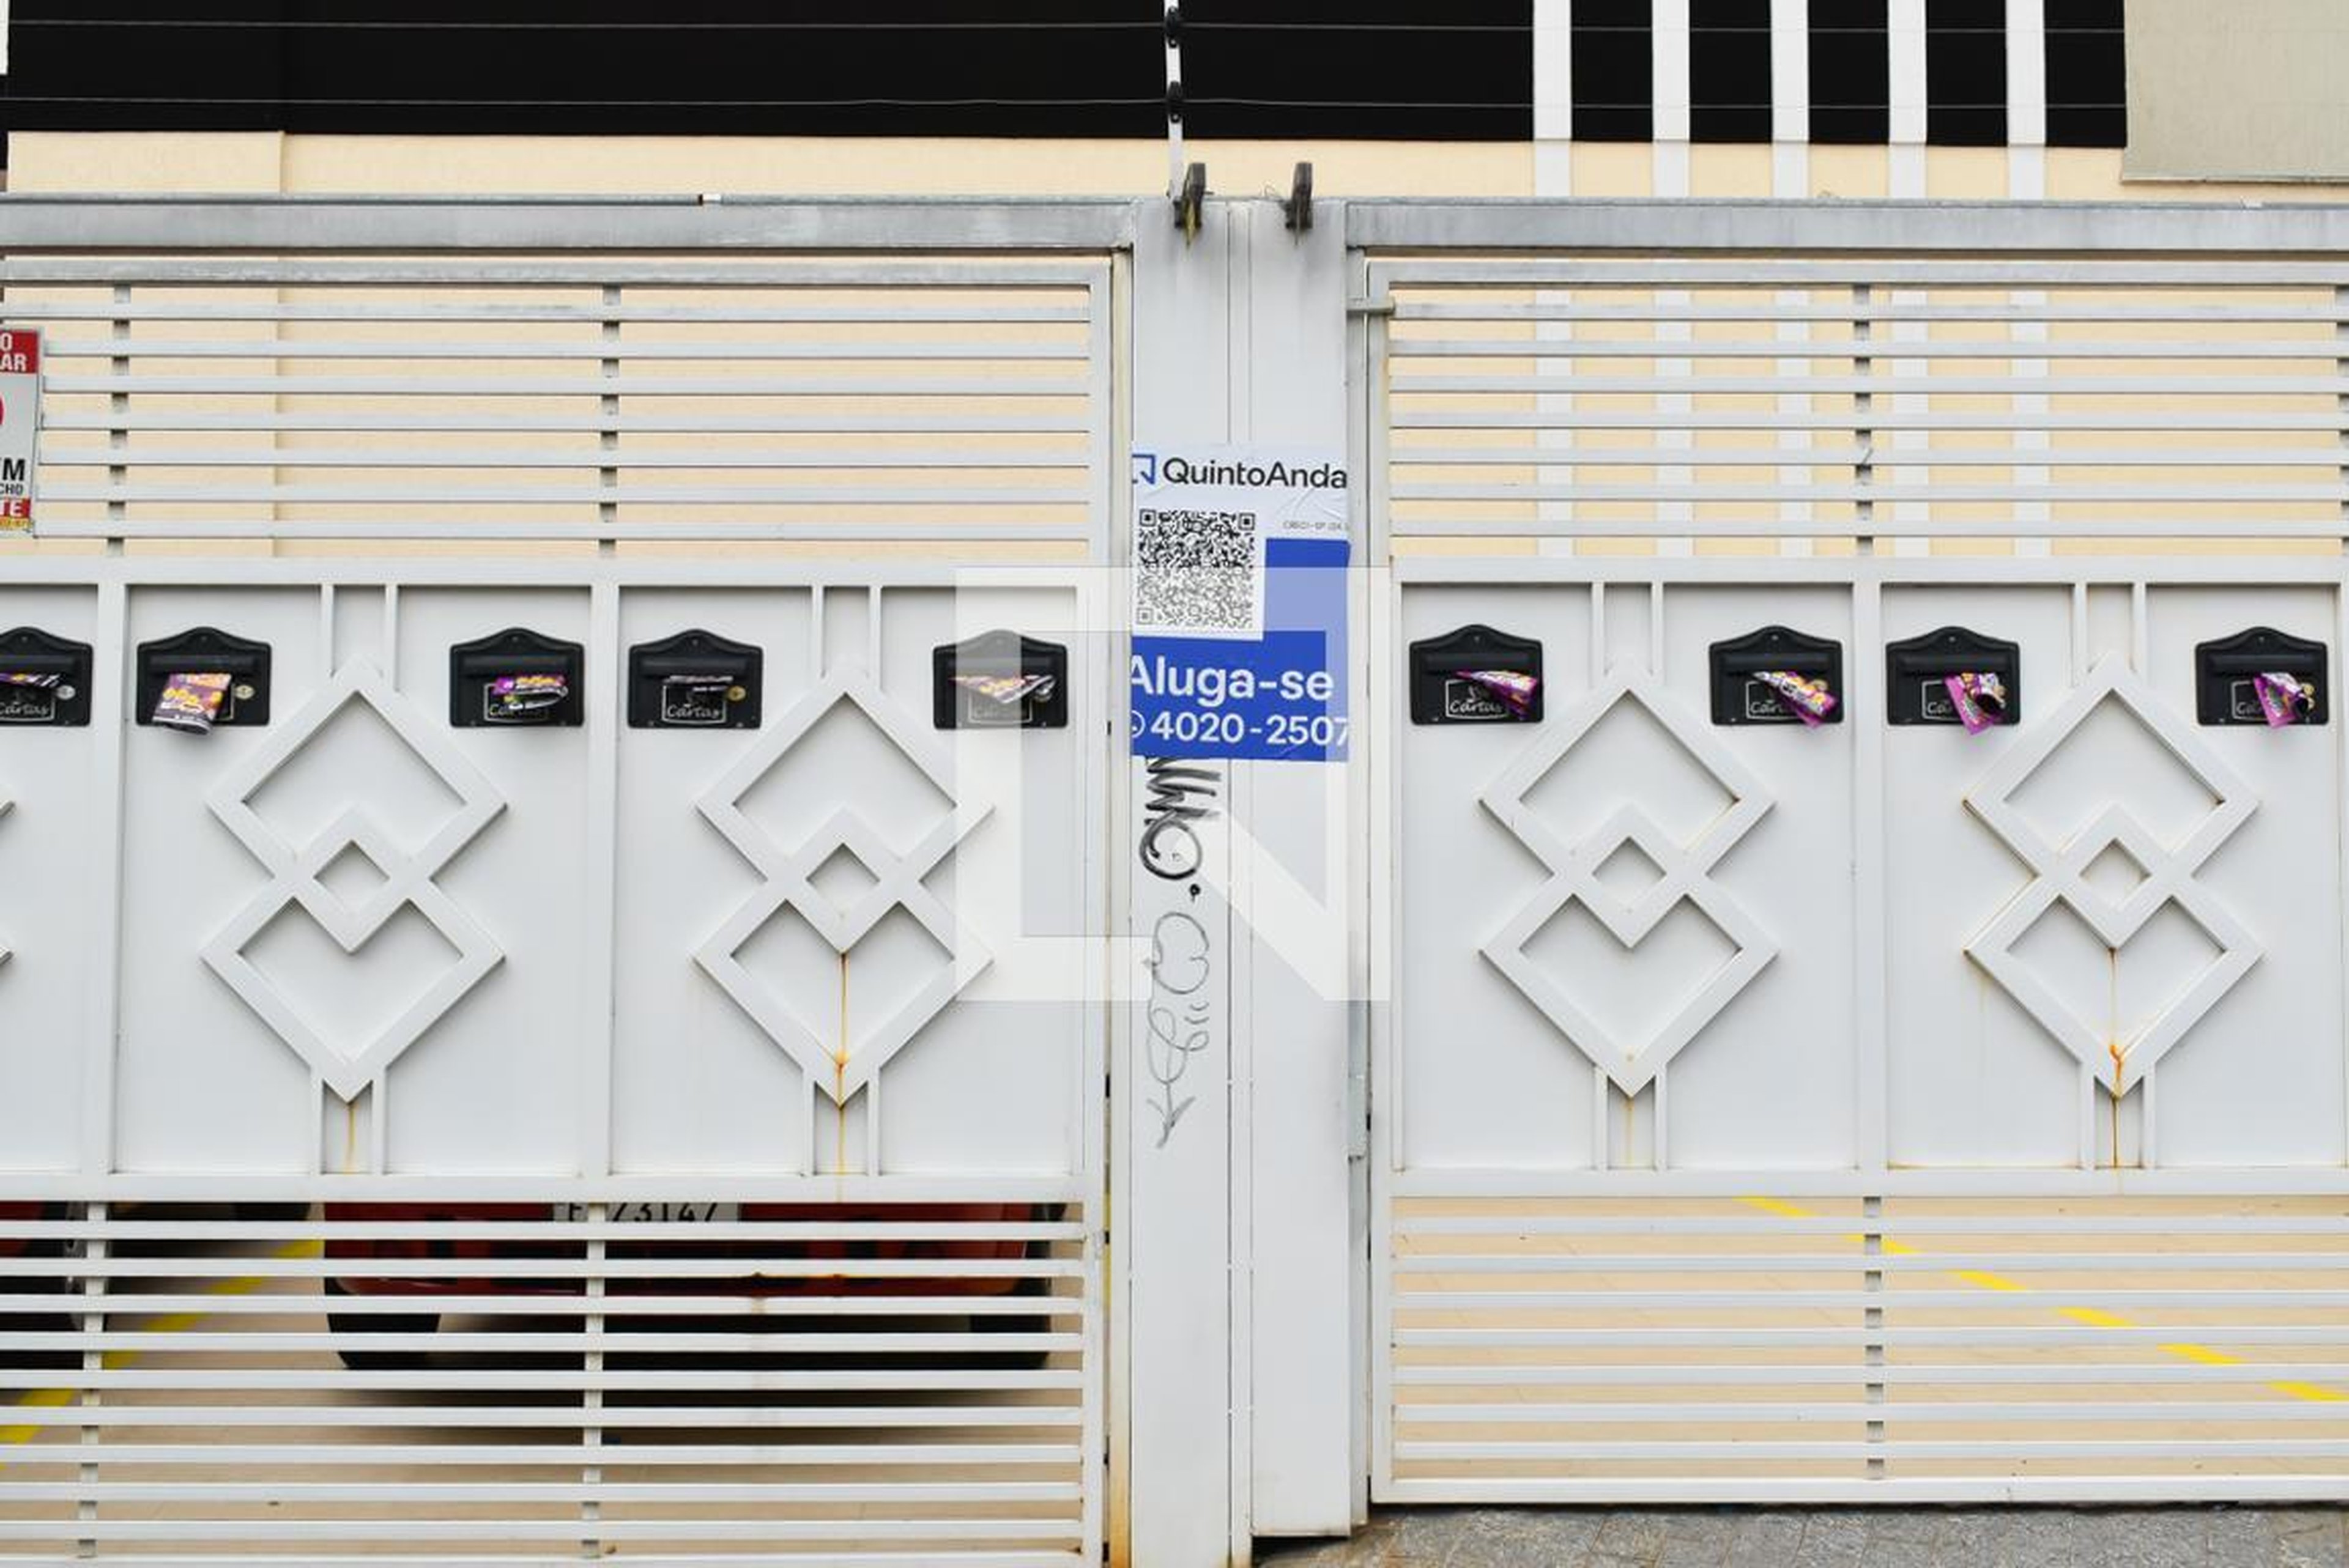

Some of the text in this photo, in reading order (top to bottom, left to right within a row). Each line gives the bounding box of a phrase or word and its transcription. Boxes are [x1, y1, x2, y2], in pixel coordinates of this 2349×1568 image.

[0, 457, 25, 481] M
[1163, 457, 1346, 489] QuintoAnda
[1131, 654, 1334, 708] Aluga-se
